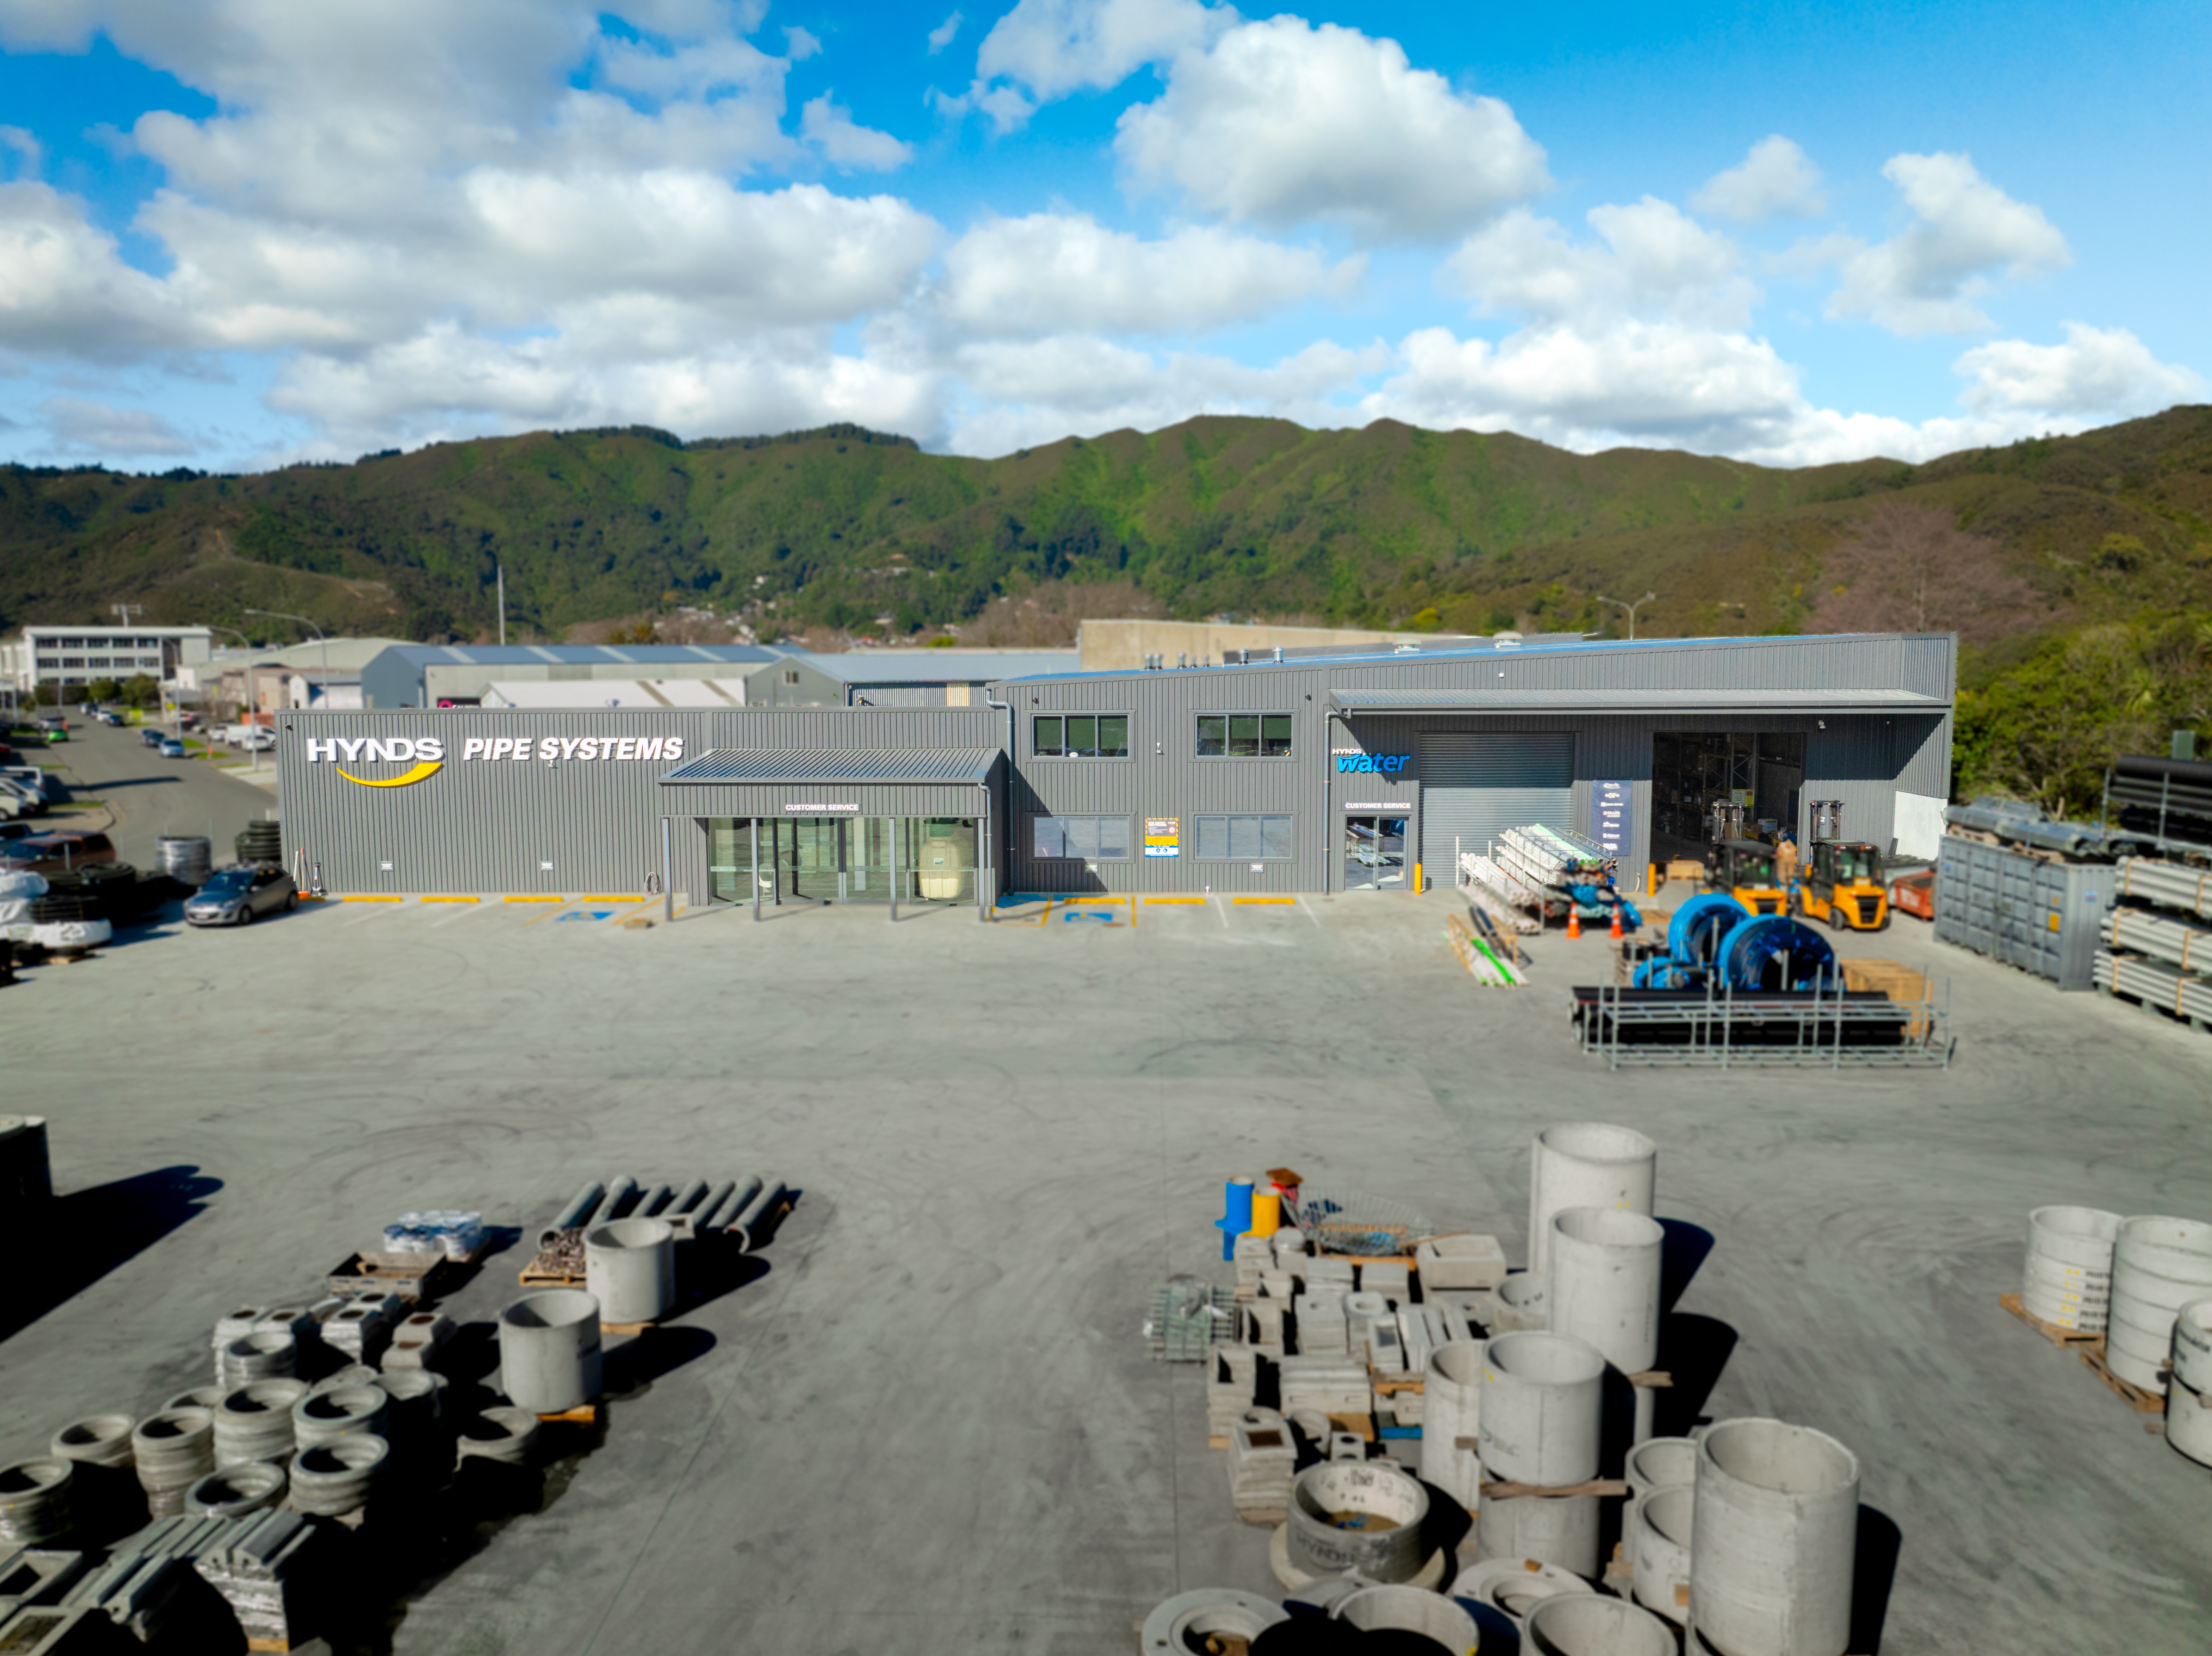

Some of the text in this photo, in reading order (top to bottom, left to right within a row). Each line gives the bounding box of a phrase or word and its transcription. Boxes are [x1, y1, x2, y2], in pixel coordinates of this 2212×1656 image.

[307, 738, 442, 761] HYNDS
[463, 737, 683, 760] PIPE SYSTEMS
[1337, 753, 1411, 773] water
